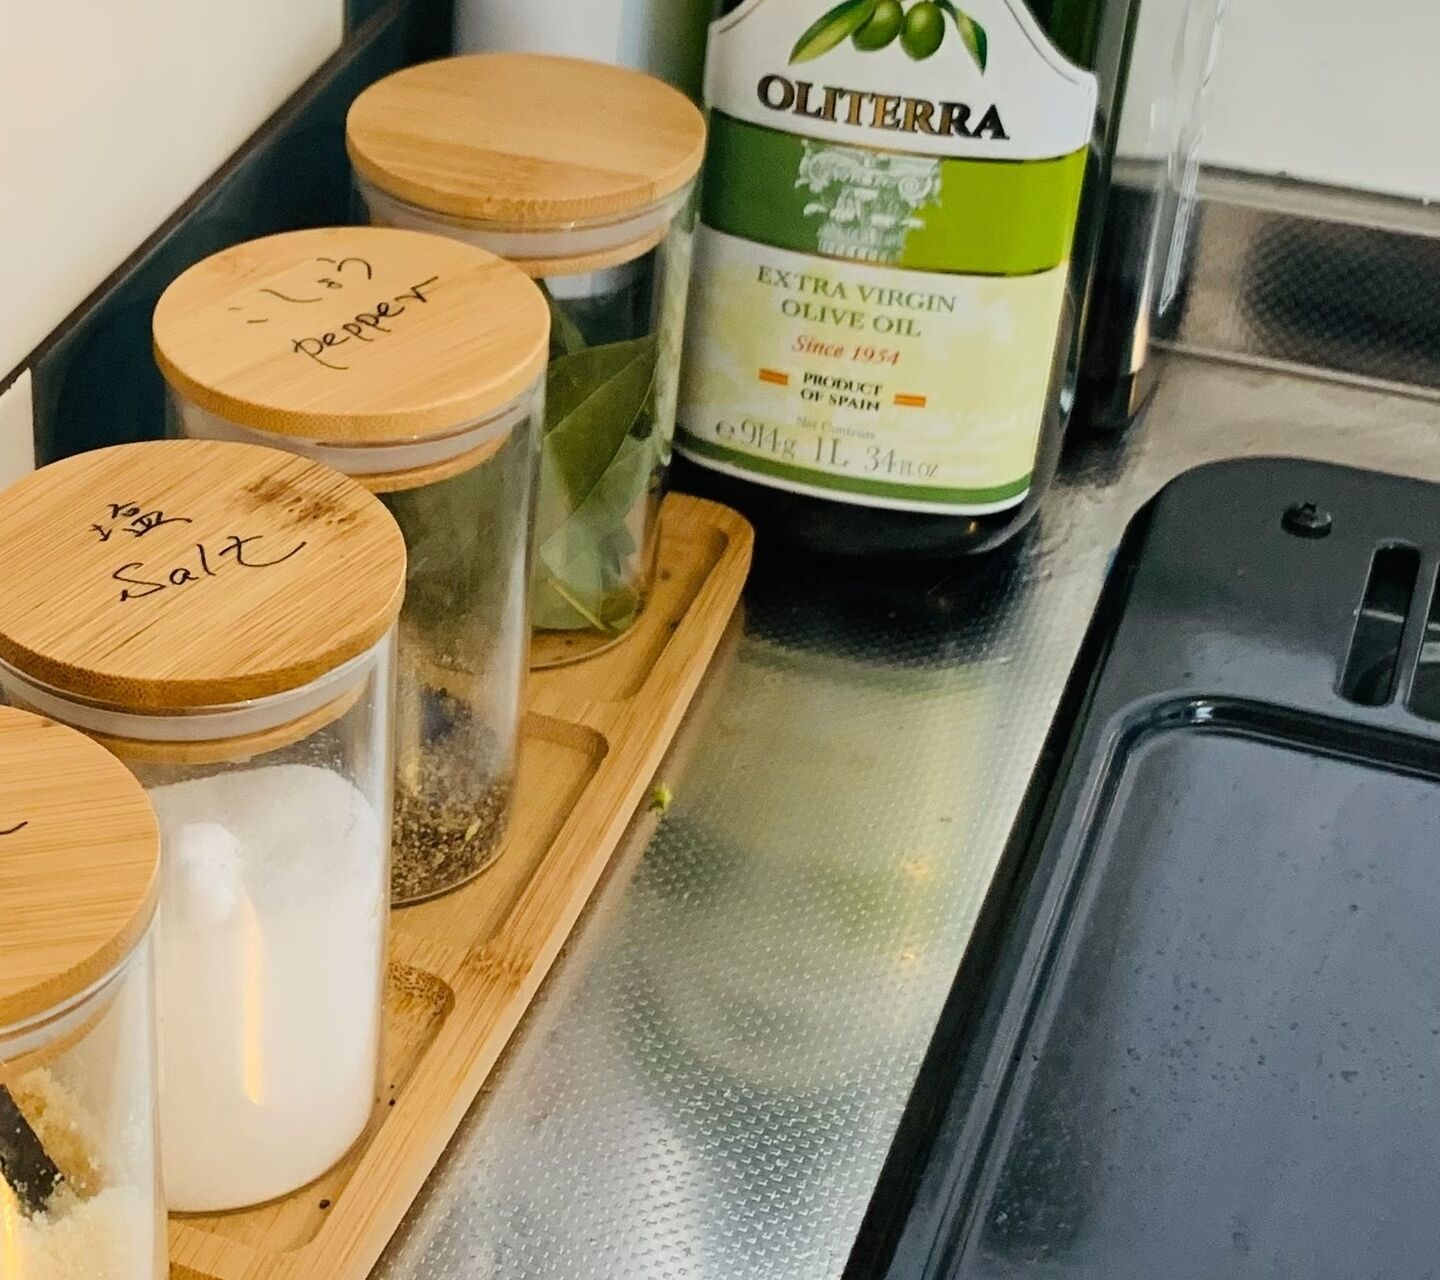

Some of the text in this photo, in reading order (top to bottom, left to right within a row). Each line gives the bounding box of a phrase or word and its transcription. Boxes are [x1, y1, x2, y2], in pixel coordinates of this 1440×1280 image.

[757, 73, 1010, 141] OLITERRA
[756, 266, 958, 313] EXTRA VIRGIN
[291, 275, 439, 371] pepper
[781, 298, 922, 338] OLIVE OIL
[791, 334, 901, 367] Since 1954
[800, 388, 880, 413] OF SPAIN
[803, 371, 884, 397] PRODUCT
[111, 534, 308, 602] Salt
